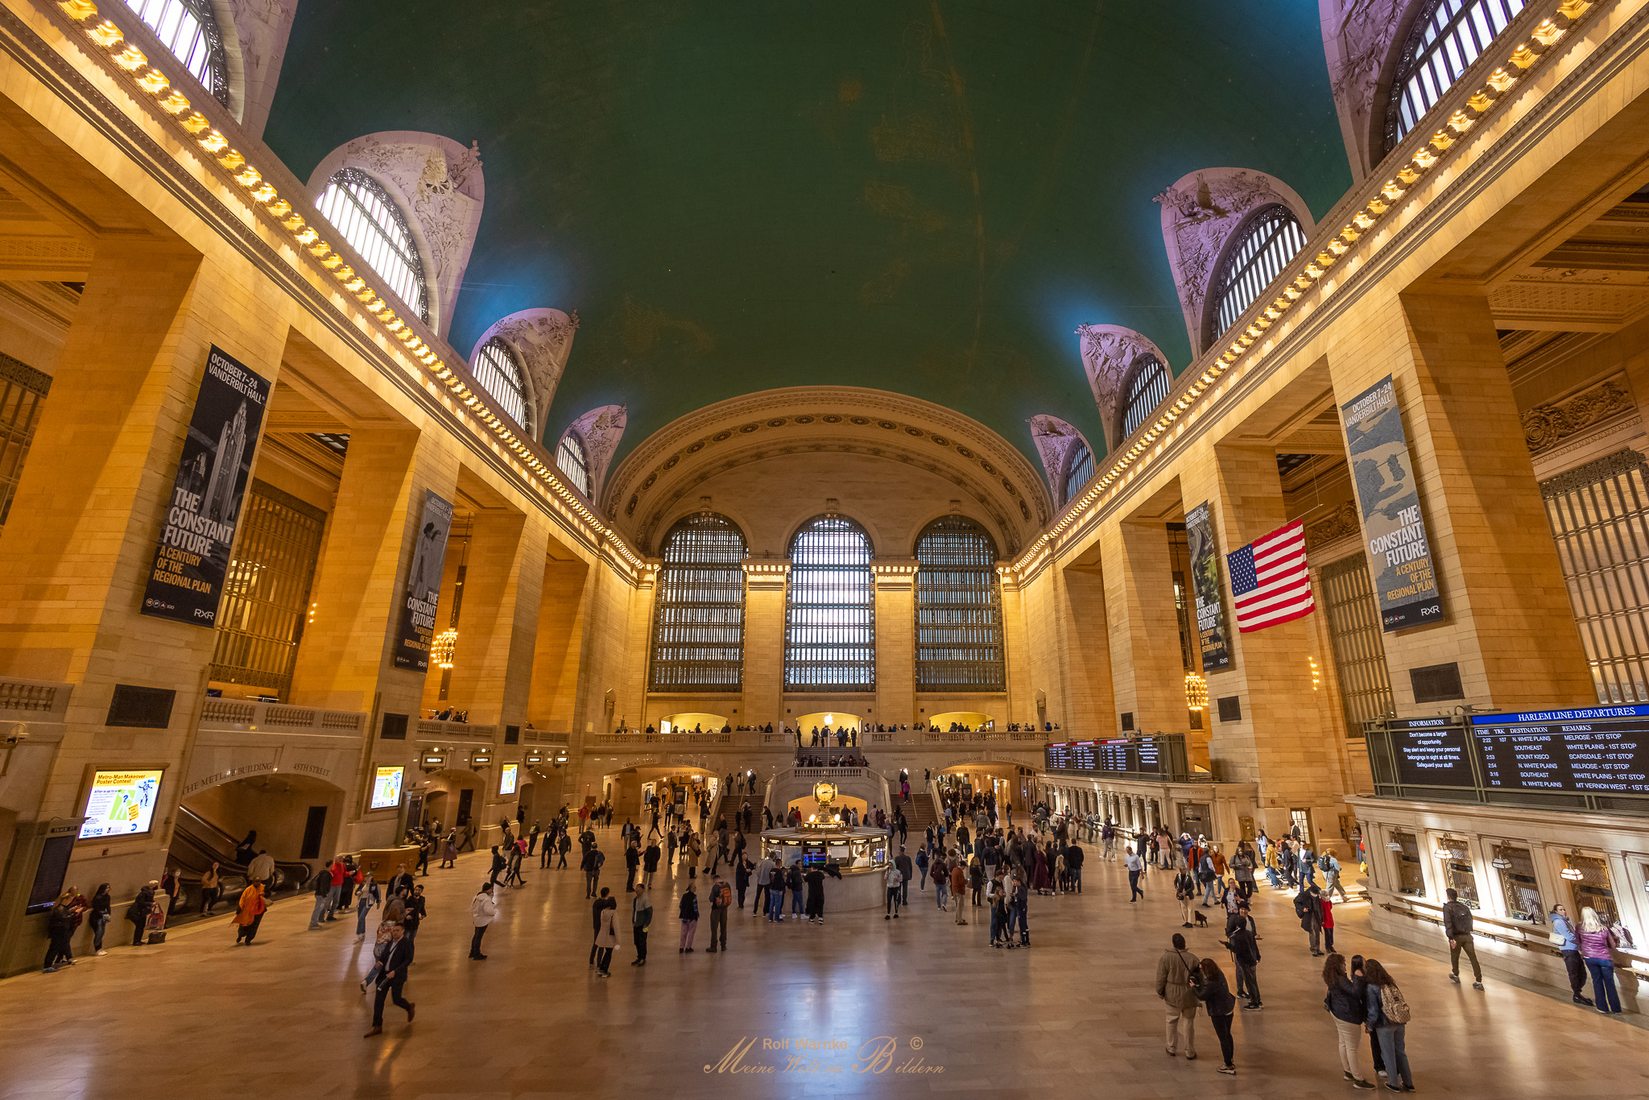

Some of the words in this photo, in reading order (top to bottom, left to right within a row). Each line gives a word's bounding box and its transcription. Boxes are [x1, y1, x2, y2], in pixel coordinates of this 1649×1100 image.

[211, 353, 242, 380] OCTOBER
[209, 363, 248, 394] VANDERBILT
[246, 387, 262, 404] HALL
[1352, 392, 1377, 413] OCTOBER
[1346, 401, 1376, 427] VANDERBILT
[176, 487, 200, 512] THE
[169, 506, 234, 543] CONSTANT
[1397, 504, 1420, 526] THE
[163, 524, 214, 557] FUTURE
[1370, 522, 1422, 555] CONSTANT
[160, 546, 166, 556] A
[166, 547, 202, 566] CENTURY
[1385, 539, 1427, 567] FUTURE
[157, 558, 169, 569] OF
[168, 560, 184, 574] THE
[1396, 566, 1401, 576] A
[1400, 558, 1430, 575] CENTURY
[1410, 572, 1420, 582] OF
[1419, 569, 1432, 581] THE
[153, 570, 191, 590] REGIONAL
[192, 580, 212, 594] PLAN
[1387, 585, 1418, 600] REGIONAL
[1417, 579, 1434, 593] PLAN
[407, 597, 437, 616] CONSTANT
[427, 591, 438, 605] THE
[194, 608, 214, 620] RXR
[412, 611, 435, 629] FUTURE
[1420, 605, 1440, 616] RXR
[1518, 713, 1552, 721] HARLEM
[1553, 711, 1574, 720] LINE
[1574, 707, 1636, 718] DEPARTURES
[237, 763, 273, 774] BUILDING
[309, 765, 330, 776] STREET
